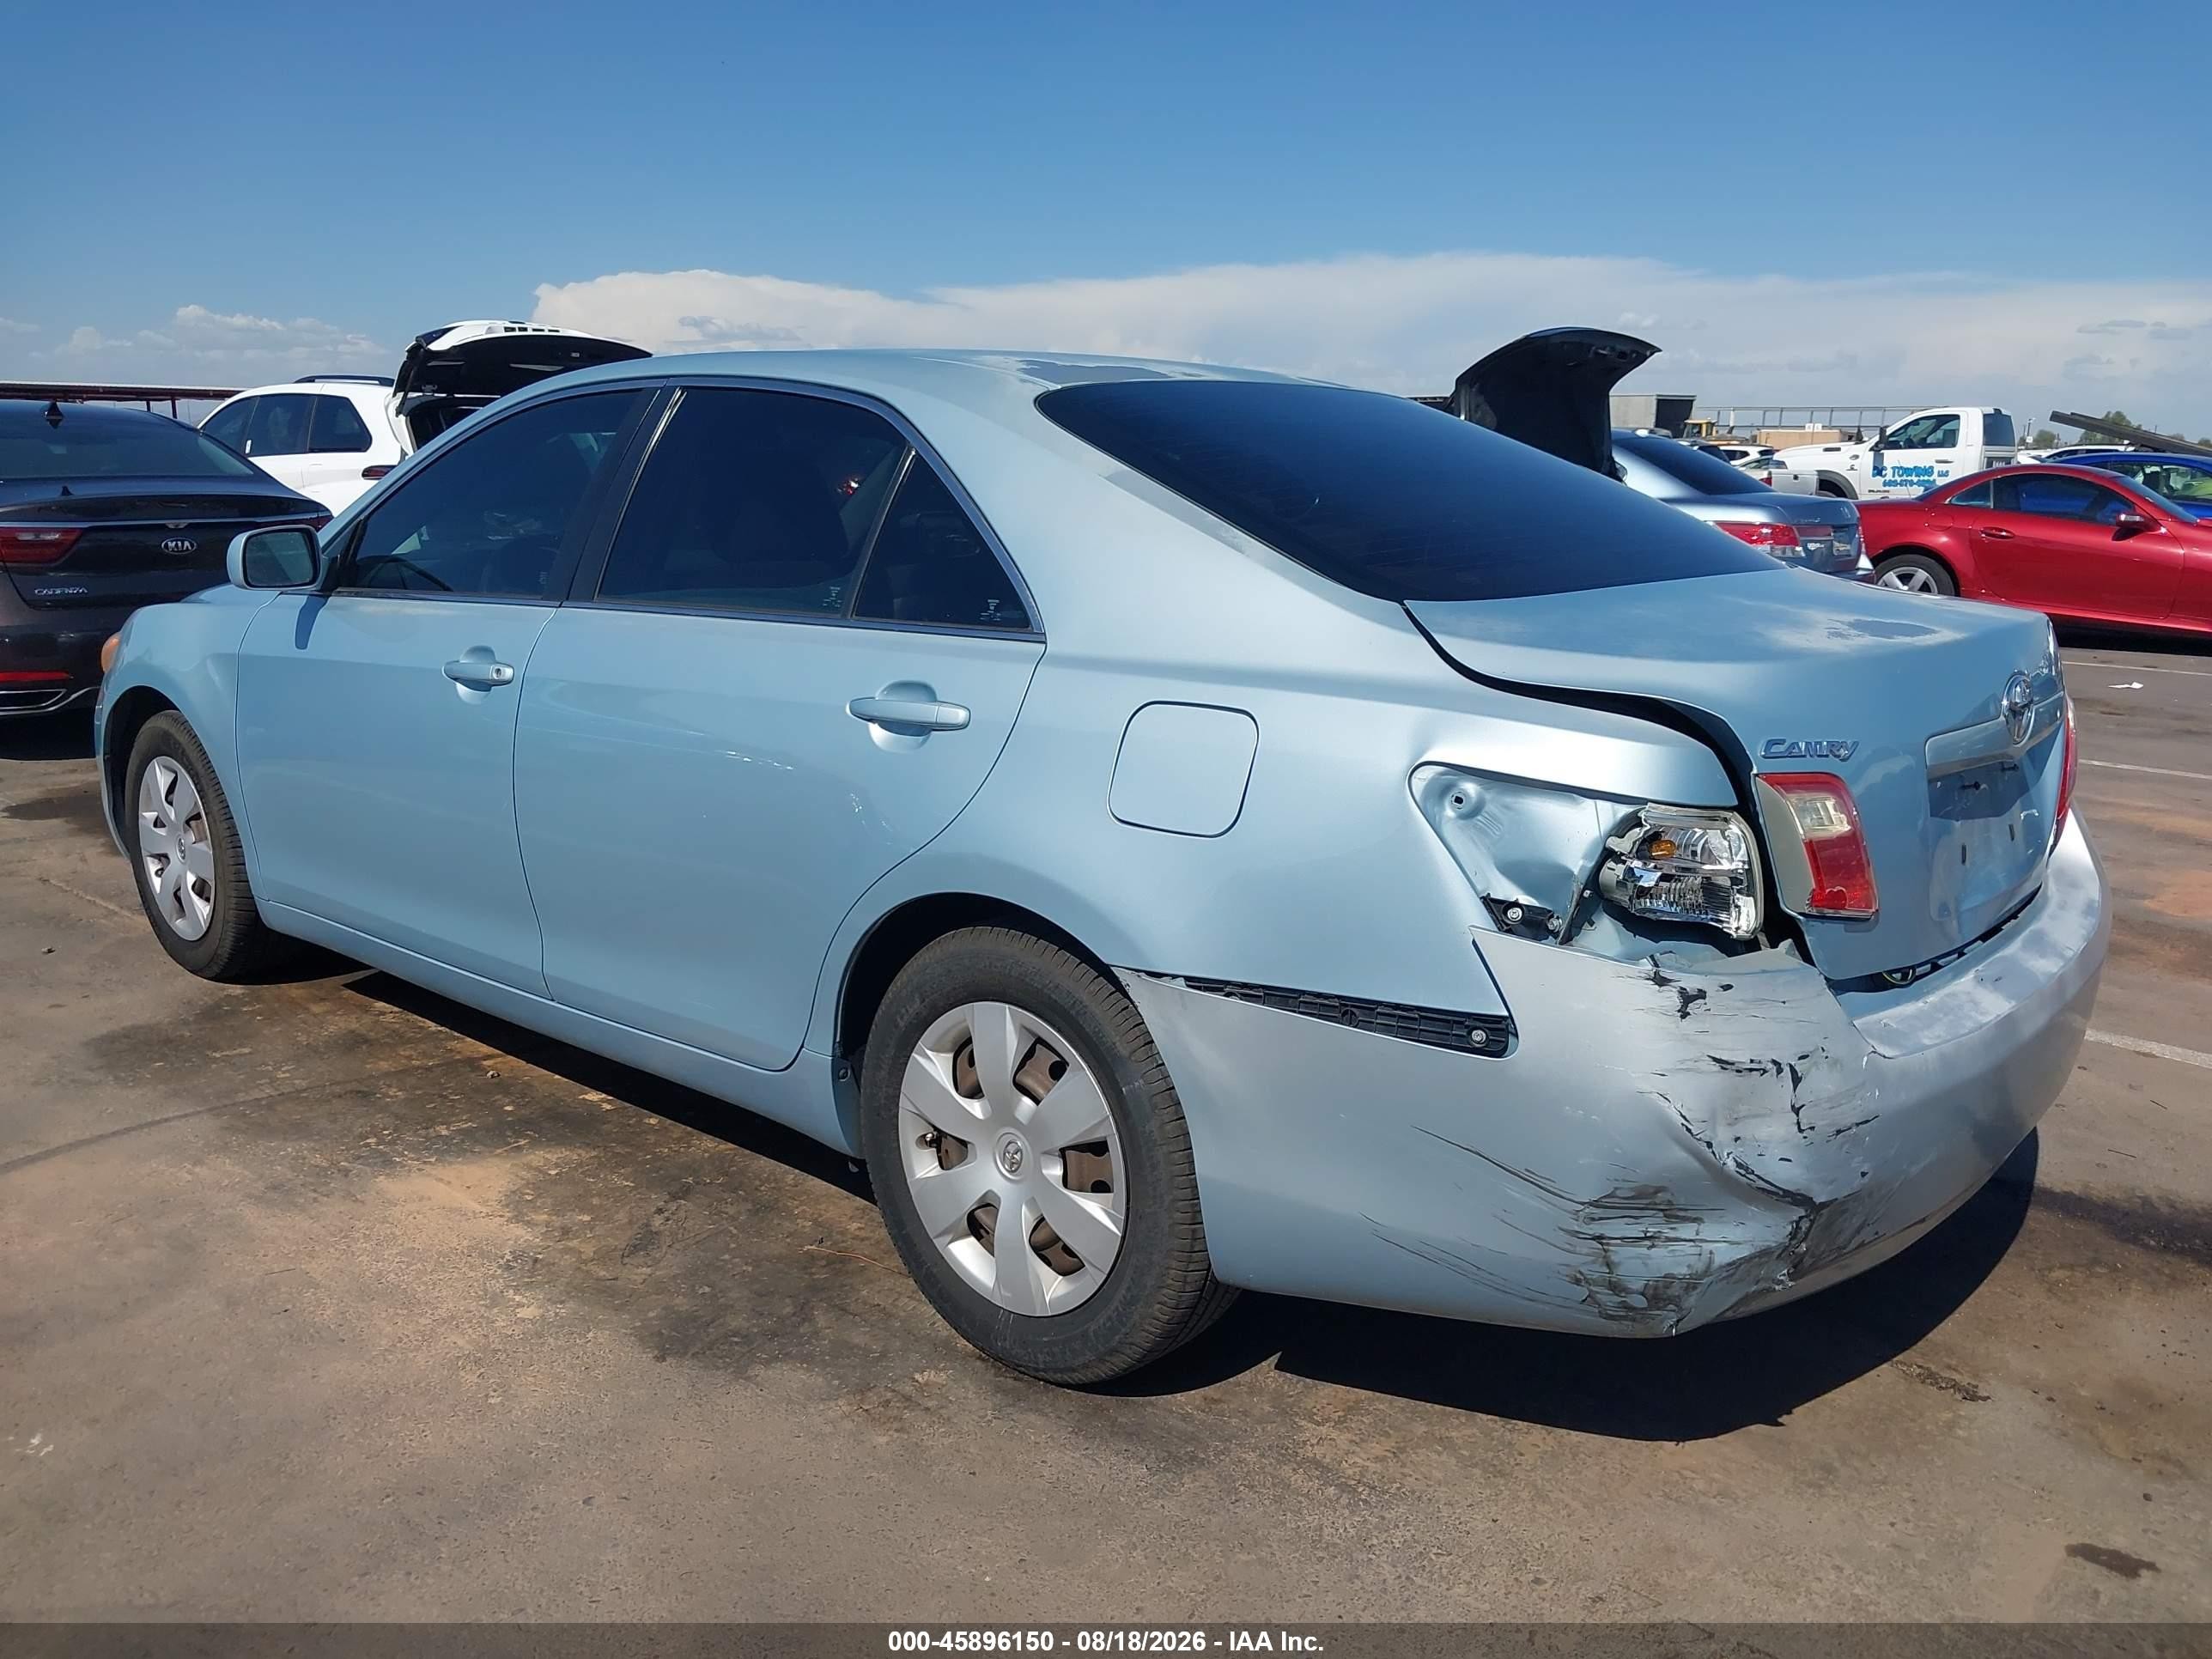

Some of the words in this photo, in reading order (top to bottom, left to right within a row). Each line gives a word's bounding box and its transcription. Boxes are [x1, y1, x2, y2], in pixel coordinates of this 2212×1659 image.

[1891, 465, 1935, 478] TOWING
[167, 540, 192, 551] KIA
[1760, 738, 1859, 762] CAMRY
